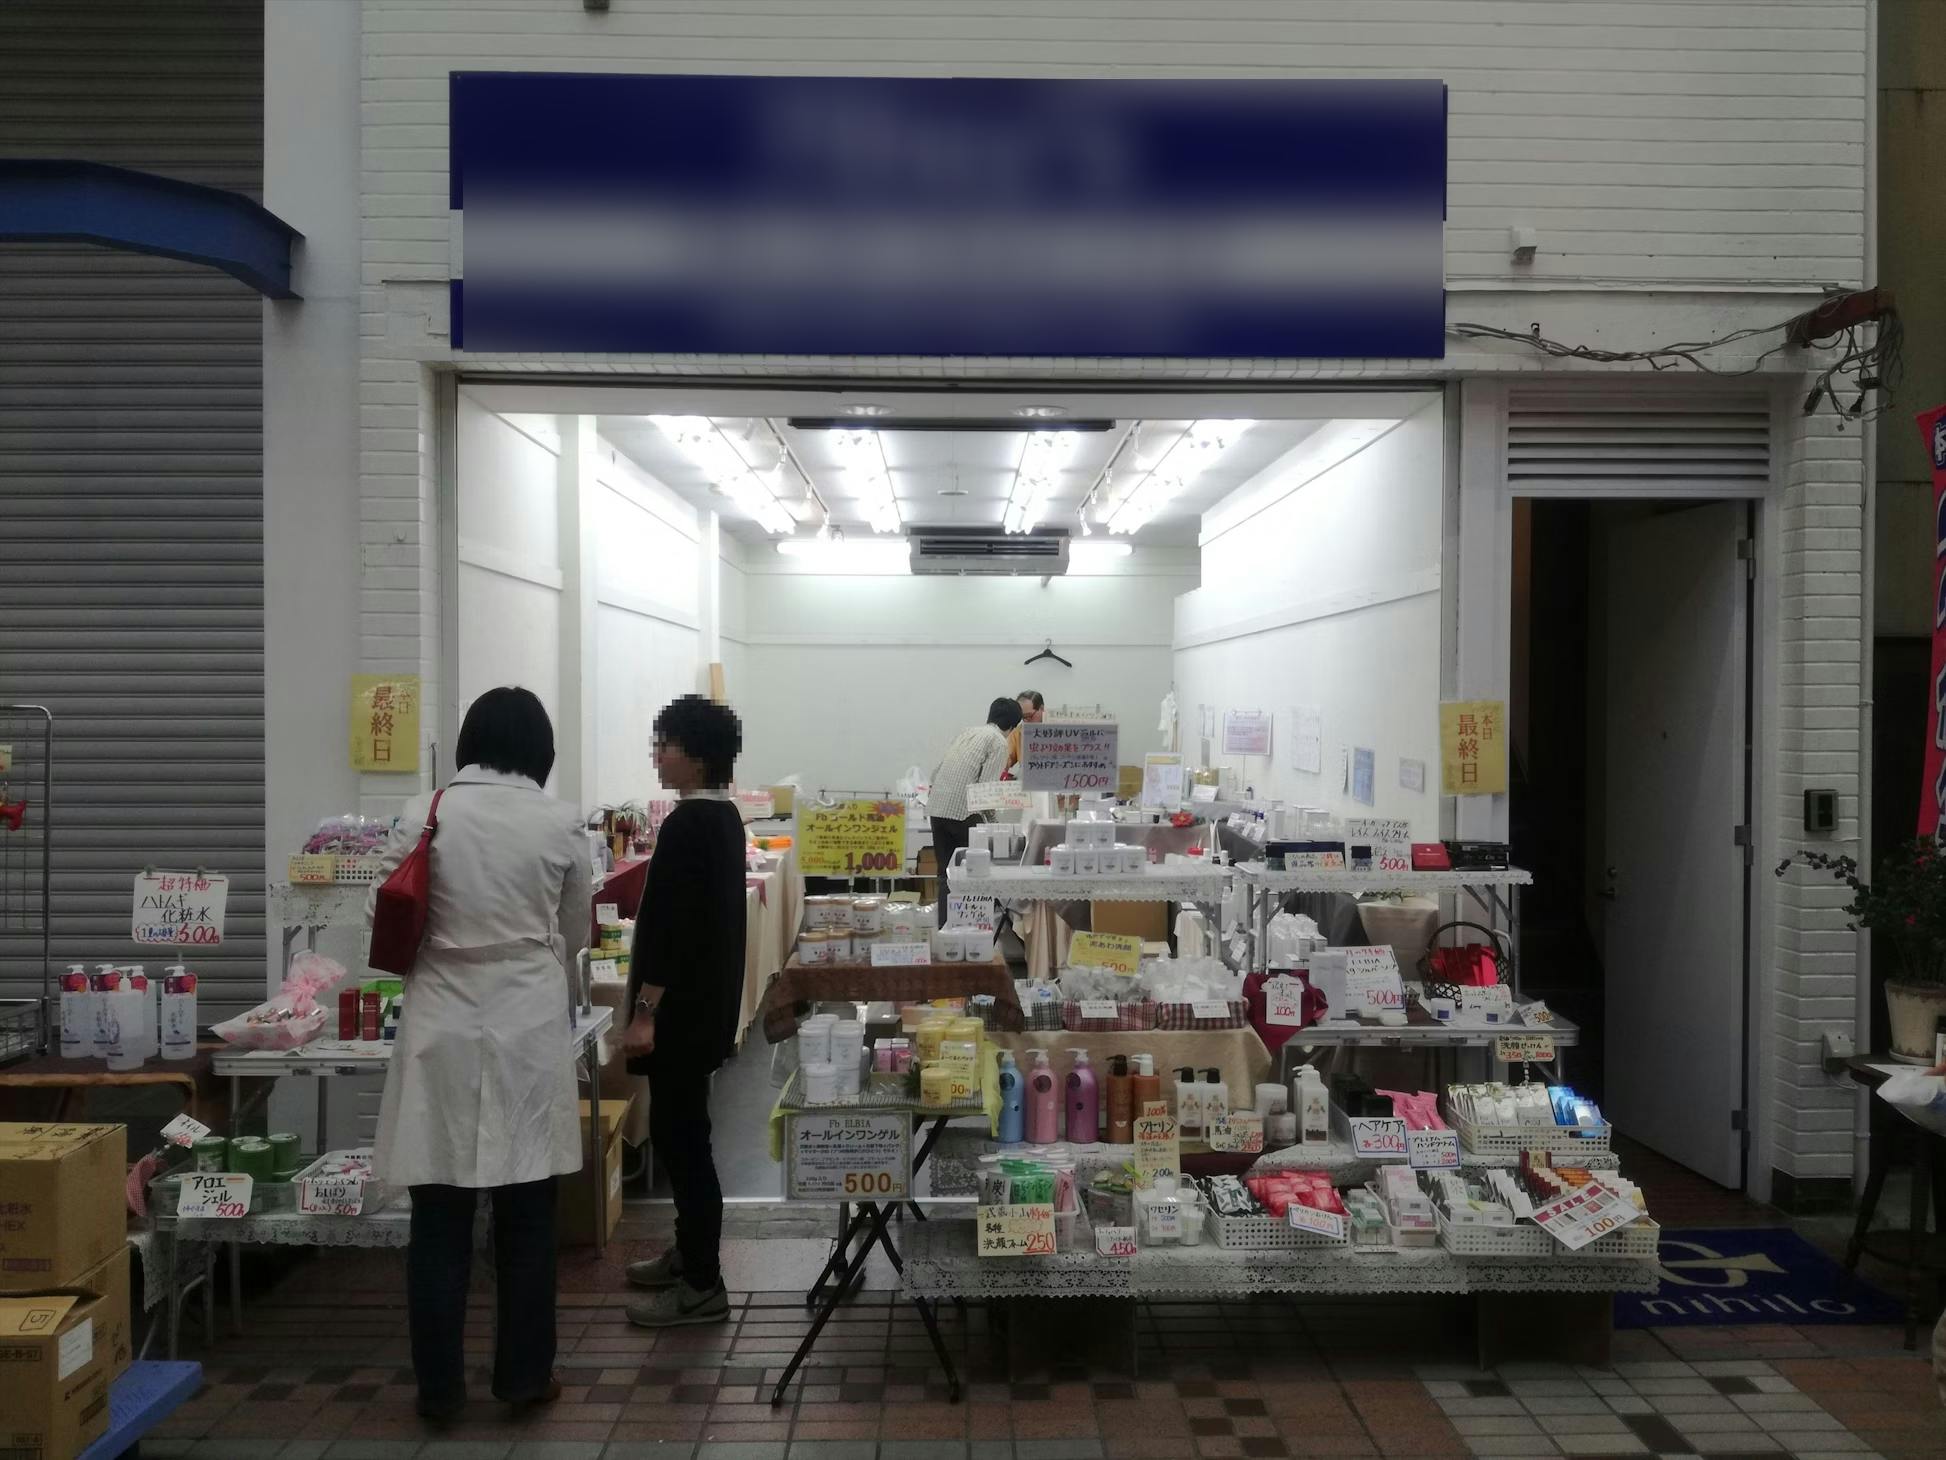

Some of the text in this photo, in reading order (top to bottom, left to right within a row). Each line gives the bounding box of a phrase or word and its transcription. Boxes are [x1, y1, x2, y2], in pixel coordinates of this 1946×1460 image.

[371, 686, 395, 761] 最終日
[1481, 714, 1493, 740] 本日
[1458, 714, 1479, 783] 最終日
[1064, 774, 1109, 789] 1500円
[806, 824, 897, 833] オールインワンジェル
[141, 893, 187, 908] ハトムギ
[161, 907, 212, 923] 化粧水
[829, 1120, 840, 1128] Fb
[1140, 1121, 1175, 1133] ワセリン
[1359, 1120, 1404, 1132] ヘアケア
[801, 1130, 900, 1140] オールインワンゲル
[192, 1176, 226, 1190] アロエ
[202, 1190, 232, 1205] ジェル
[1151, 1206, 1178, 1214] ワセリン
[1027, 1232, 1055, 1250] 250
